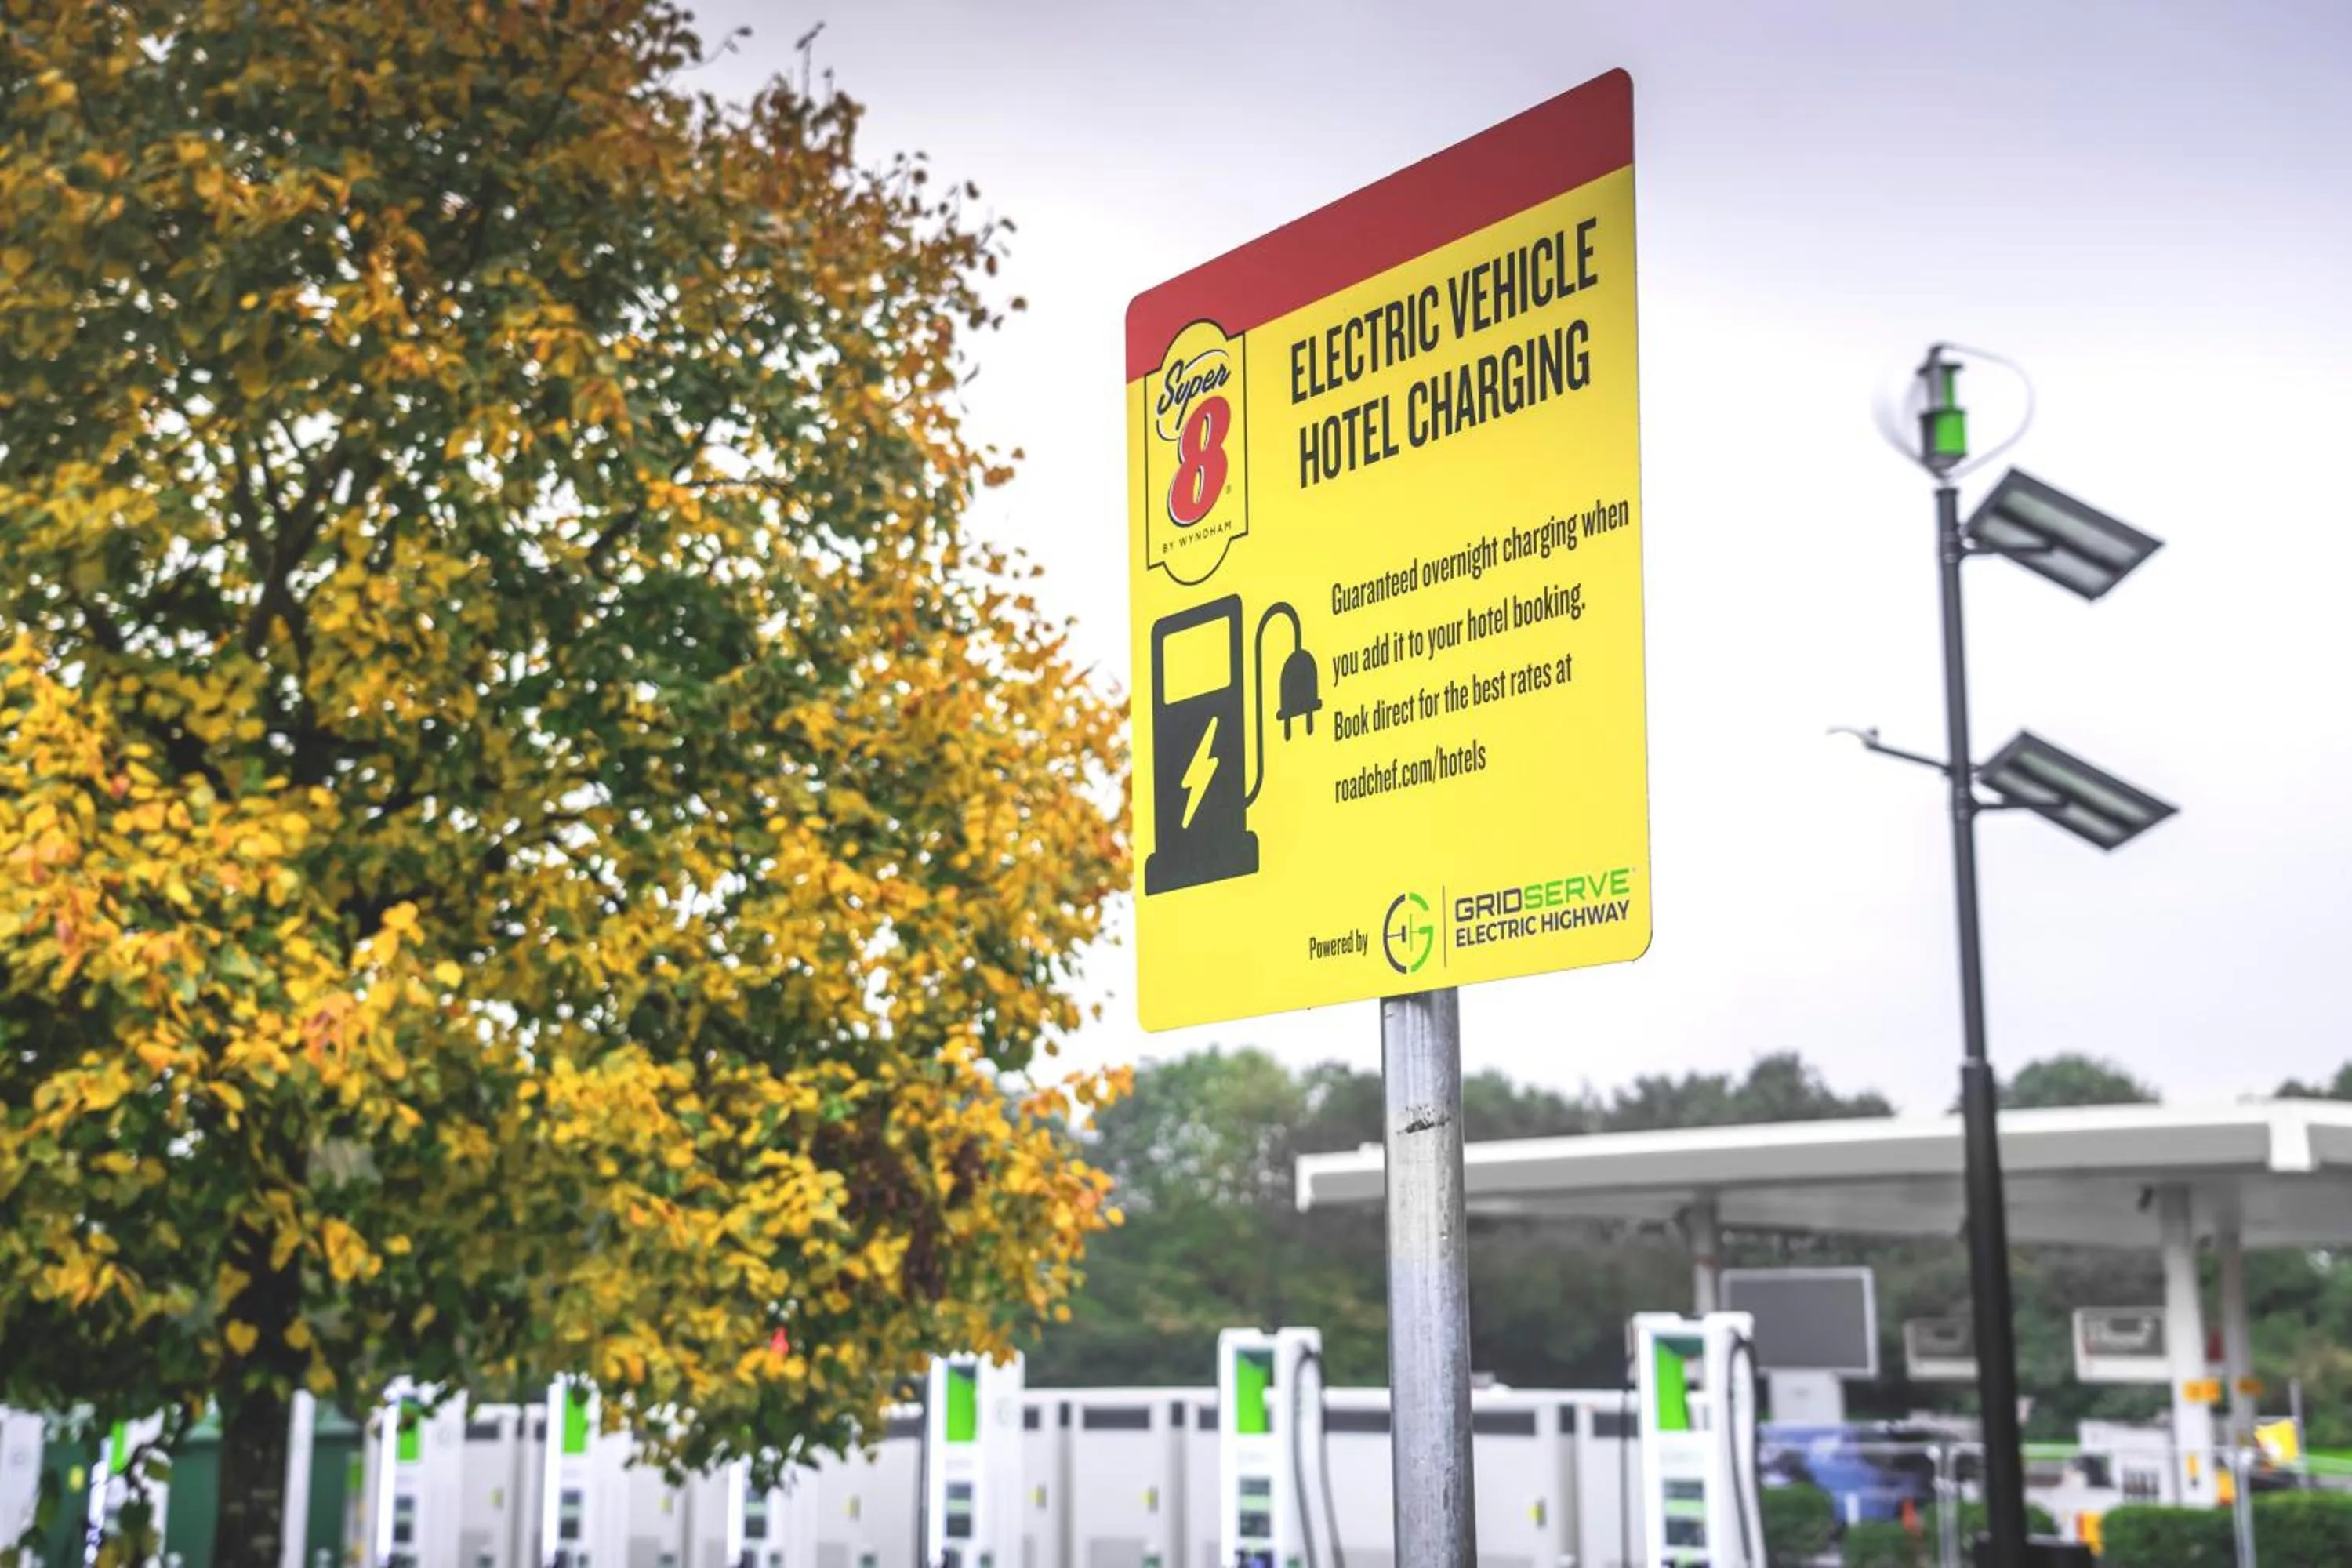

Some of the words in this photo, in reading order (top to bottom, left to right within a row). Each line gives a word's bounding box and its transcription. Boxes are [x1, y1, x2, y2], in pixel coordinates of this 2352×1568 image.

[1290, 284, 1439, 405] ELECTRIC
[1447, 216, 1598, 339] VEHICLE
[1156, 358, 1232, 432] Super
[1299, 394, 1399, 489] HOTEL
[1407, 318, 1591, 448] CHARGING
[1167, 395, 1232, 528] 8
[1163, 541, 1174, 554] BY
[1179, 521, 1232, 547] WYNDHAM
[1331, 557, 1417, 615] Guaranteed
[1422, 535, 1497, 586] overnight
[1502, 513, 1577, 563] charging
[1581, 499, 1628, 539] when
[1332, 649, 1359, 687] you
[1362, 635, 1388, 669] add
[1393, 632, 1404, 662] it
[1408, 630, 1424, 659] to
[1428, 618, 1463, 660] your
[1467, 597, 1508, 642] hotel
[1512, 582, 1586, 629] booking.
[1334, 705, 1370, 742] Book
[1373, 694, 1414, 731] direct
[1418, 687, 1440, 717] for
[1444, 680, 1468, 713] the
[1472, 670, 1506, 706] best
[1510, 660, 1552, 697] rates
[1555, 652, 1573, 684] at
[1334, 739, 1486, 804] roadchef.com/hotels
[1454, 867, 1630, 924] GRIDSERVE
[1455, 915, 1537, 949] ELECTRIC
[1541, 899, 1630, 934] HIGHWAY
[1308, 930, 1355, 960] Powered
[1356, 929, 1368, 957] by
